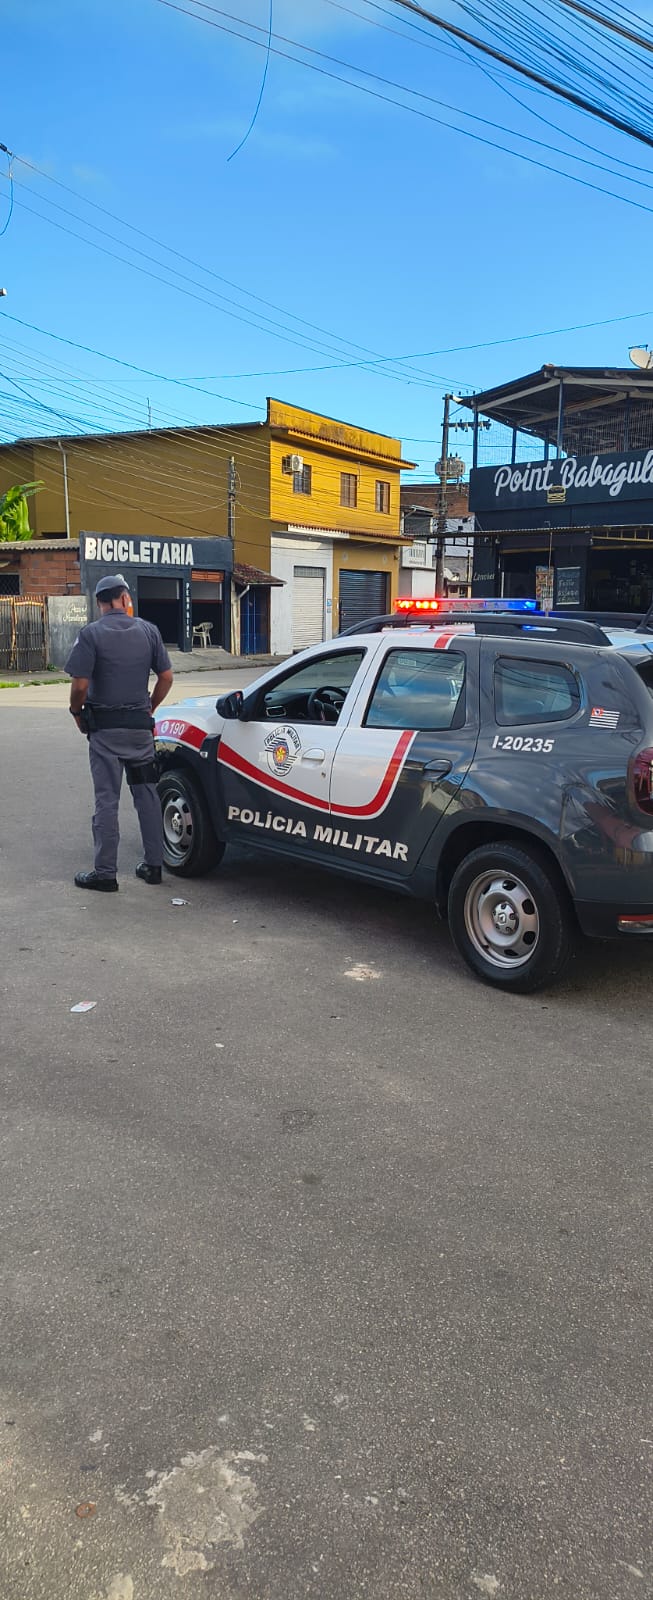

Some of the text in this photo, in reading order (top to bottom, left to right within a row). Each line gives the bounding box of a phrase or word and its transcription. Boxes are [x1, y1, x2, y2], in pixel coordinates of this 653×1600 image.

[494, 449, 653, 497] Point Babagul
[84, 536, 194, 566] BICICLETARIA
[169, 721, 185, 736] 190
[492, 735, 555, 753] I-20235
[227, 805, 409, 862] POLÍCIA MILITAR
